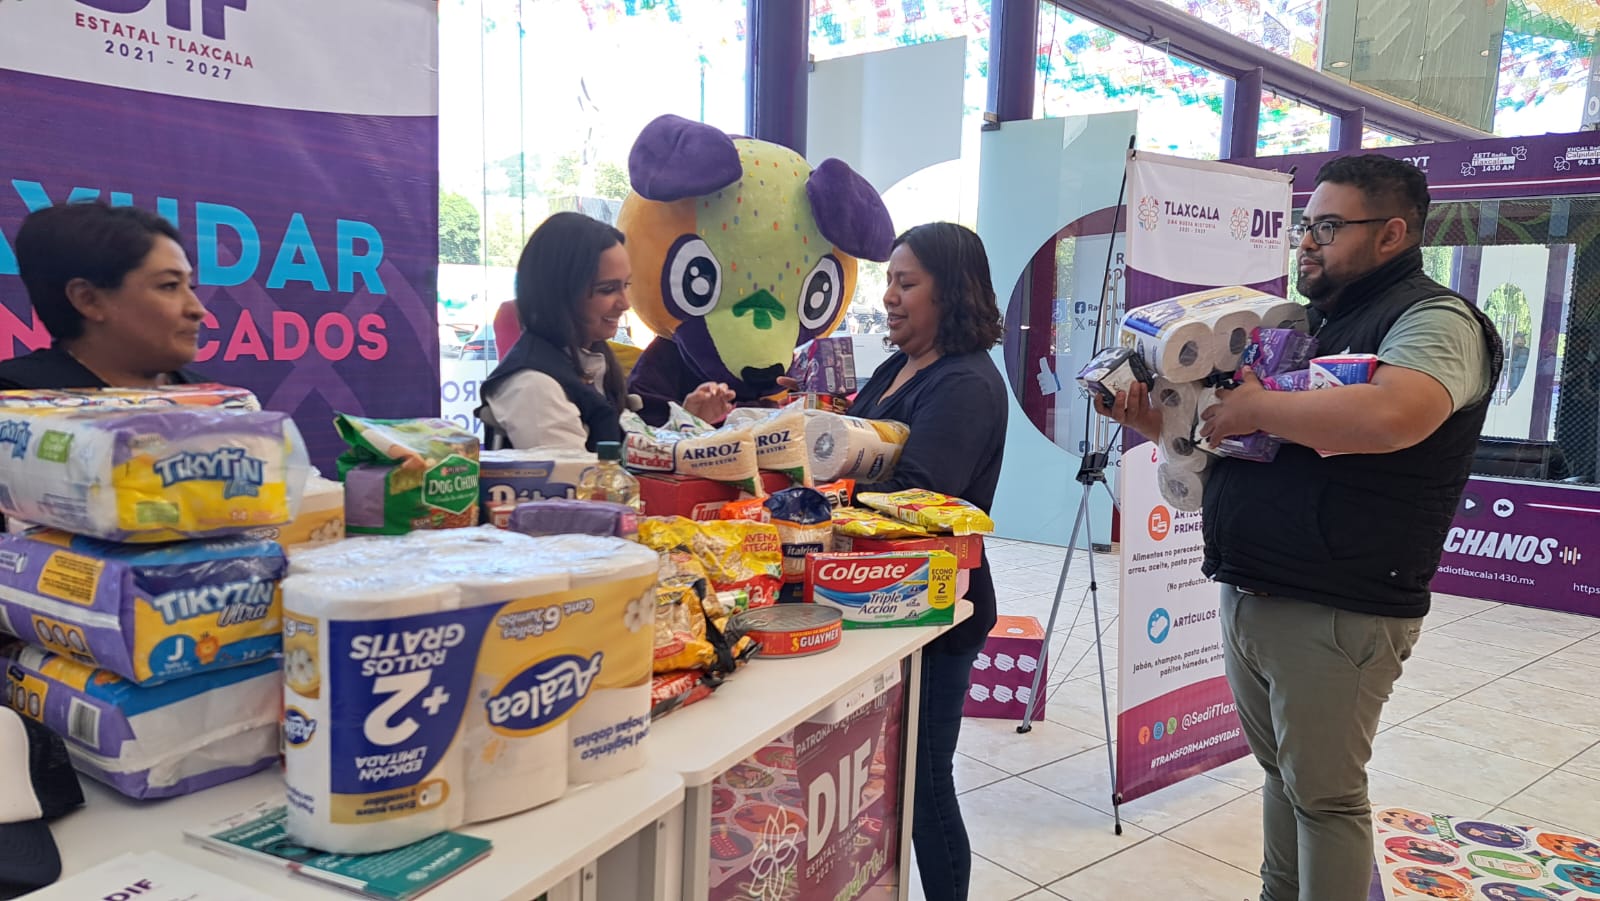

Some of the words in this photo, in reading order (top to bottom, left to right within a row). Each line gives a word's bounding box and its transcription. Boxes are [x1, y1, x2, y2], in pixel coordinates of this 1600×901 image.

[75, 12, 160, 45] ESTATAL
[167, 36, 254, 68] TLAXCALA
[105, 40, 155, 63] 2021
[186, 59, 232, 80] 2027
[1578, 158, 1596, 166] 94.3
[1164, 201, 1220, 220] TLAXCALA
[1251, 208, 1284, 238] DIF
[682, 441, 742, 460] ARROZ
[428, 479, 453, 495] DOG
[454, 474, 478, 492] CHOW
[744, 533, 778, 543] AVENA
[1442, 526, 1559, 565] CHANOS
[1128, 566, 1148, 575] arroz,
[1148, 562, 1170, 572] aceite,
[1171, 558, 1188, 569] pasta
[1188, 556, 1203, 567] para
[1132, 551, 1164, 562] Alimentos
[818, 563, 906, 584] Colgate
[931, 568, 954, 576] ECONO
[938, 583, 947, 594] 2
[1166, 583, 1177, 593] (No
[1178, 577, 1207, 590] productos
[869, 591, 902, 604] Triple
[496, 609, 545, 629] Jumbo
[544, 605, 561, 632] 6
[858, 603, 898, 615] Acción
[1173, 609, 1216, 628] ARTÍCULOS
[350, 624, 465, 660] GRATIS
[501, 622, 545, 641] Rollos
[167, 638, 185, 661] J
[1133, 661, 1153, 674] Jabón,
[1154, 654, 1183, 667] shampoo,
[1183, 648, 1200, 660] pasta
[1200, 642, 1220, 654] dental,
[362, 650, 447, 676] ROLLOS
[1160, 665, 1181, 678] pañitos
[1182, 657, 1209, 670] húmedos,
[487, 652, 605, 722] Azálea
[615, 716, 644, 734] hojas
[573, 726, 614, 749] dobles
[1151, 727, 1241, 769] #TRANSFORMAMOSVIDAS
[355, 746, 427, 769] LIMITADA
[360, 757, 424, 783] EDICIÓN
[807, 738, 871, 862] DIF
[103, 878, 153, 901] DIF
